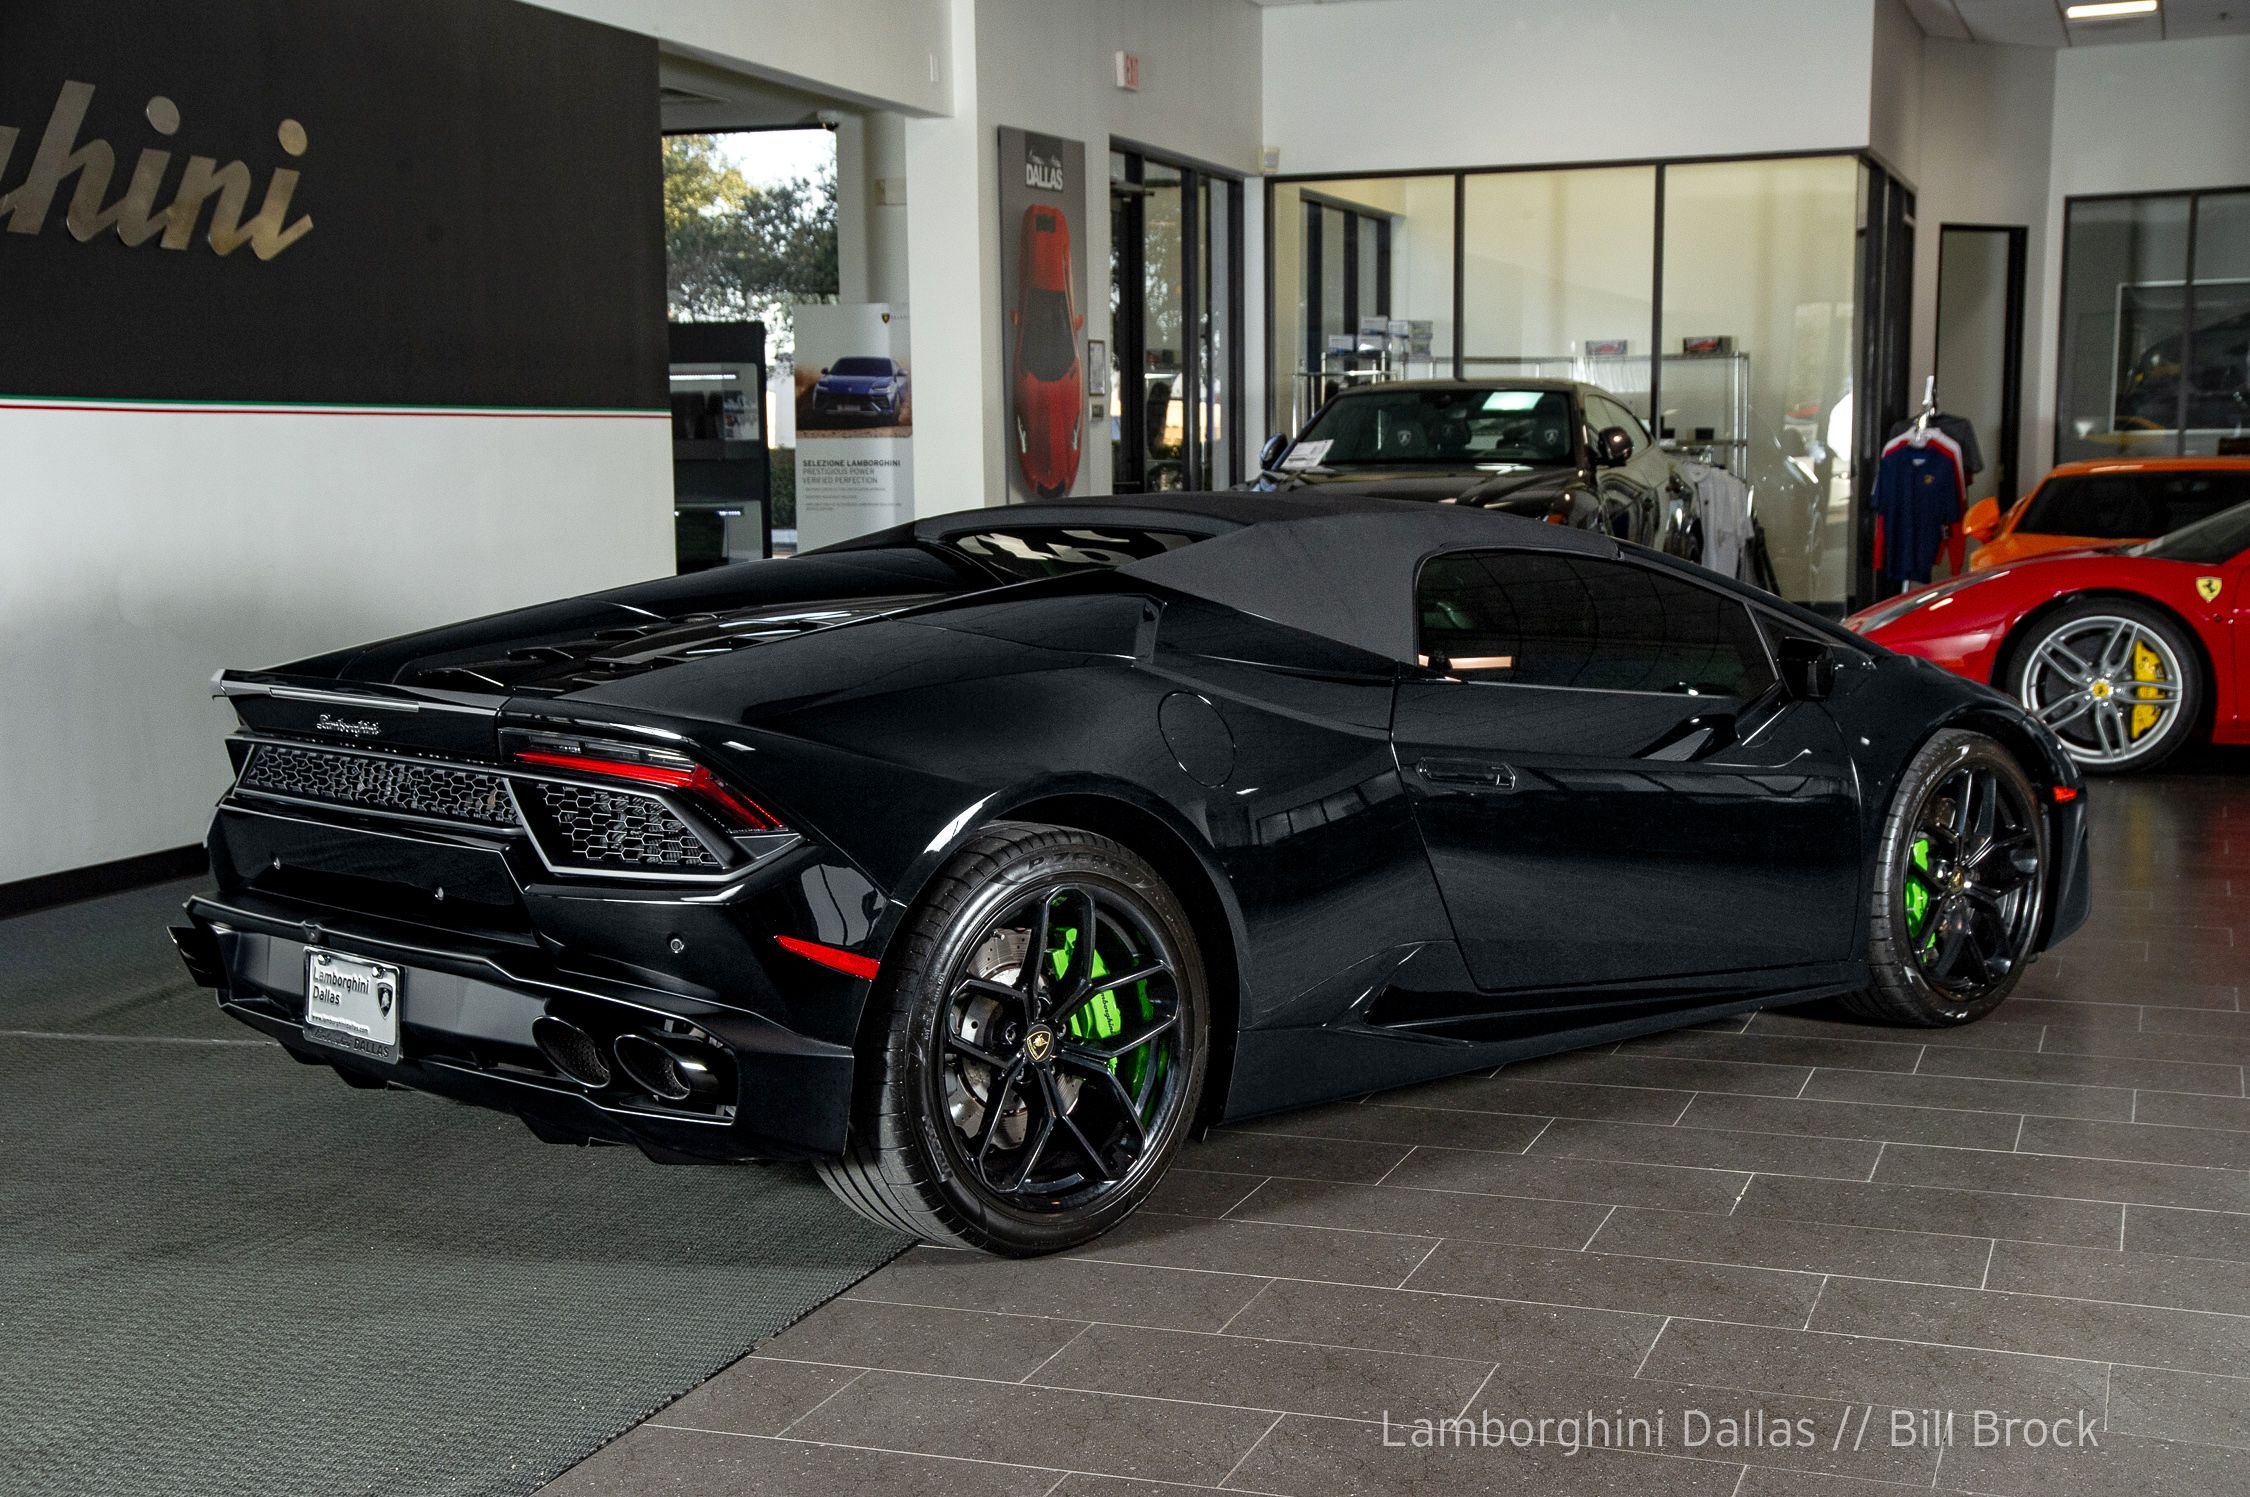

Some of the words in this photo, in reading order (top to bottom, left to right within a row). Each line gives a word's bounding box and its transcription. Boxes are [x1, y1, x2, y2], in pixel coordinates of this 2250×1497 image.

[0, 79, 314, 261] hini
[1025, 162, 1064, 191] DALLAS
[802, 459, 845, 467] SELEZIONE
[846, 459, 901, 467] LAMBORGHINI
[313, 966, 370, 996] Lamborghini
[313, 984, 341, 1006] Dallas
[353, 1037, 390, 1058] DALLAS
